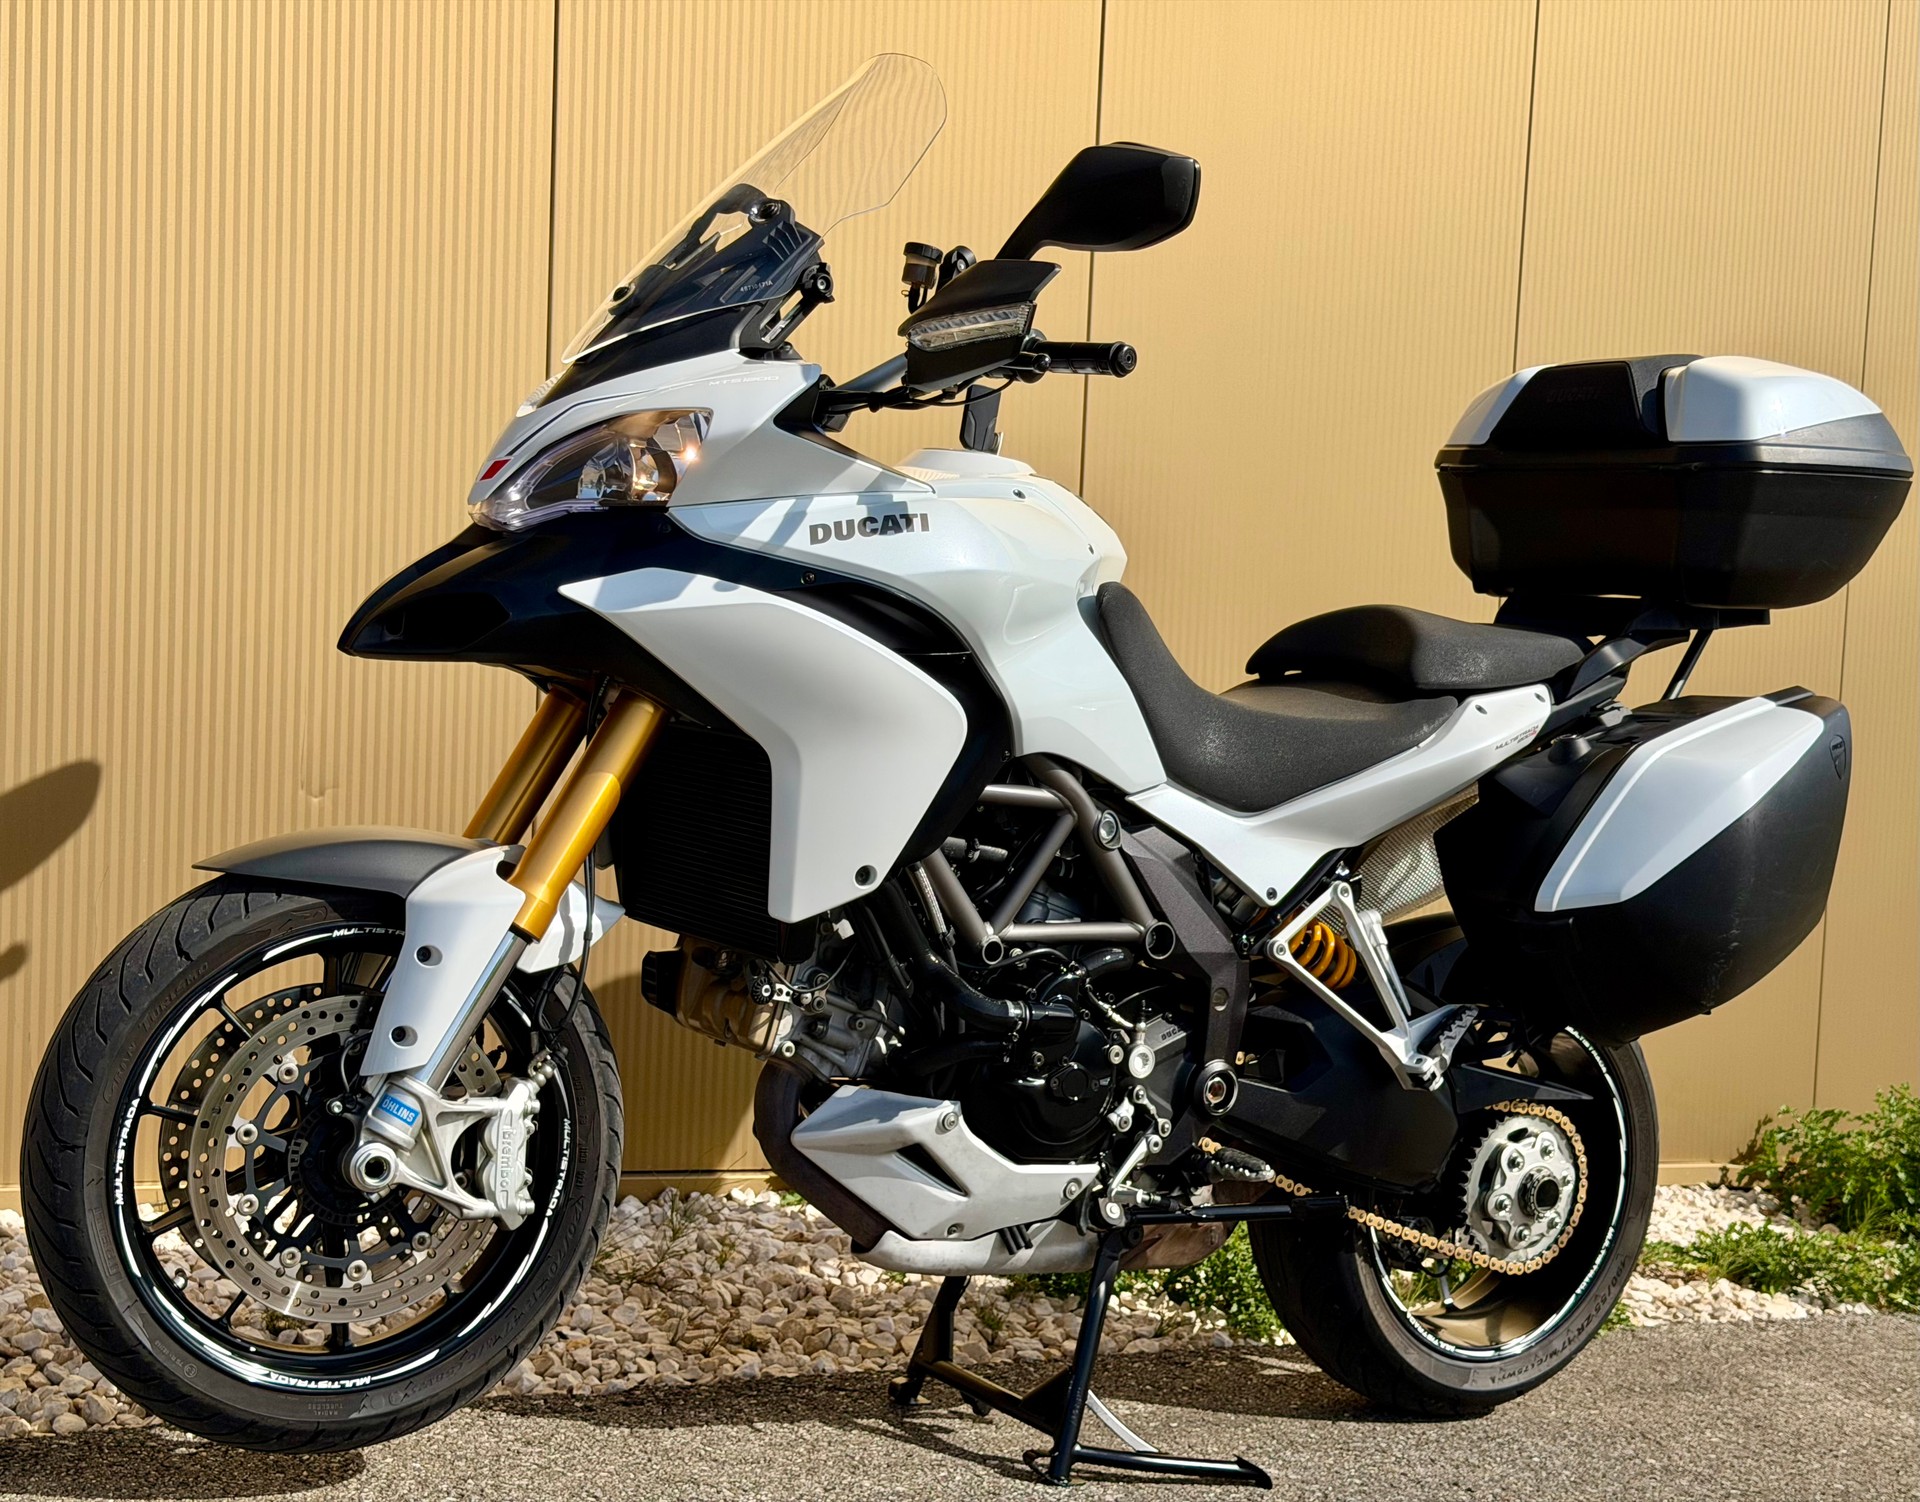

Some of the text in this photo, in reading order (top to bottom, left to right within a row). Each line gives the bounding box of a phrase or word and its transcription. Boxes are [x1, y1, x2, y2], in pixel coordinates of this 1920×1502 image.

[809, 513, 930, 545] DUCATI
[332, 926, 405, 938] MULTISTR
[381, 1095, 416, 1122] ÖHLINS
[114, 1097, 141, 1206] MULTISTRADA
[545, 1118, 572, 1217] MULTISTRADA
[268, 1371, 372, 1389] MULTISTRADA
